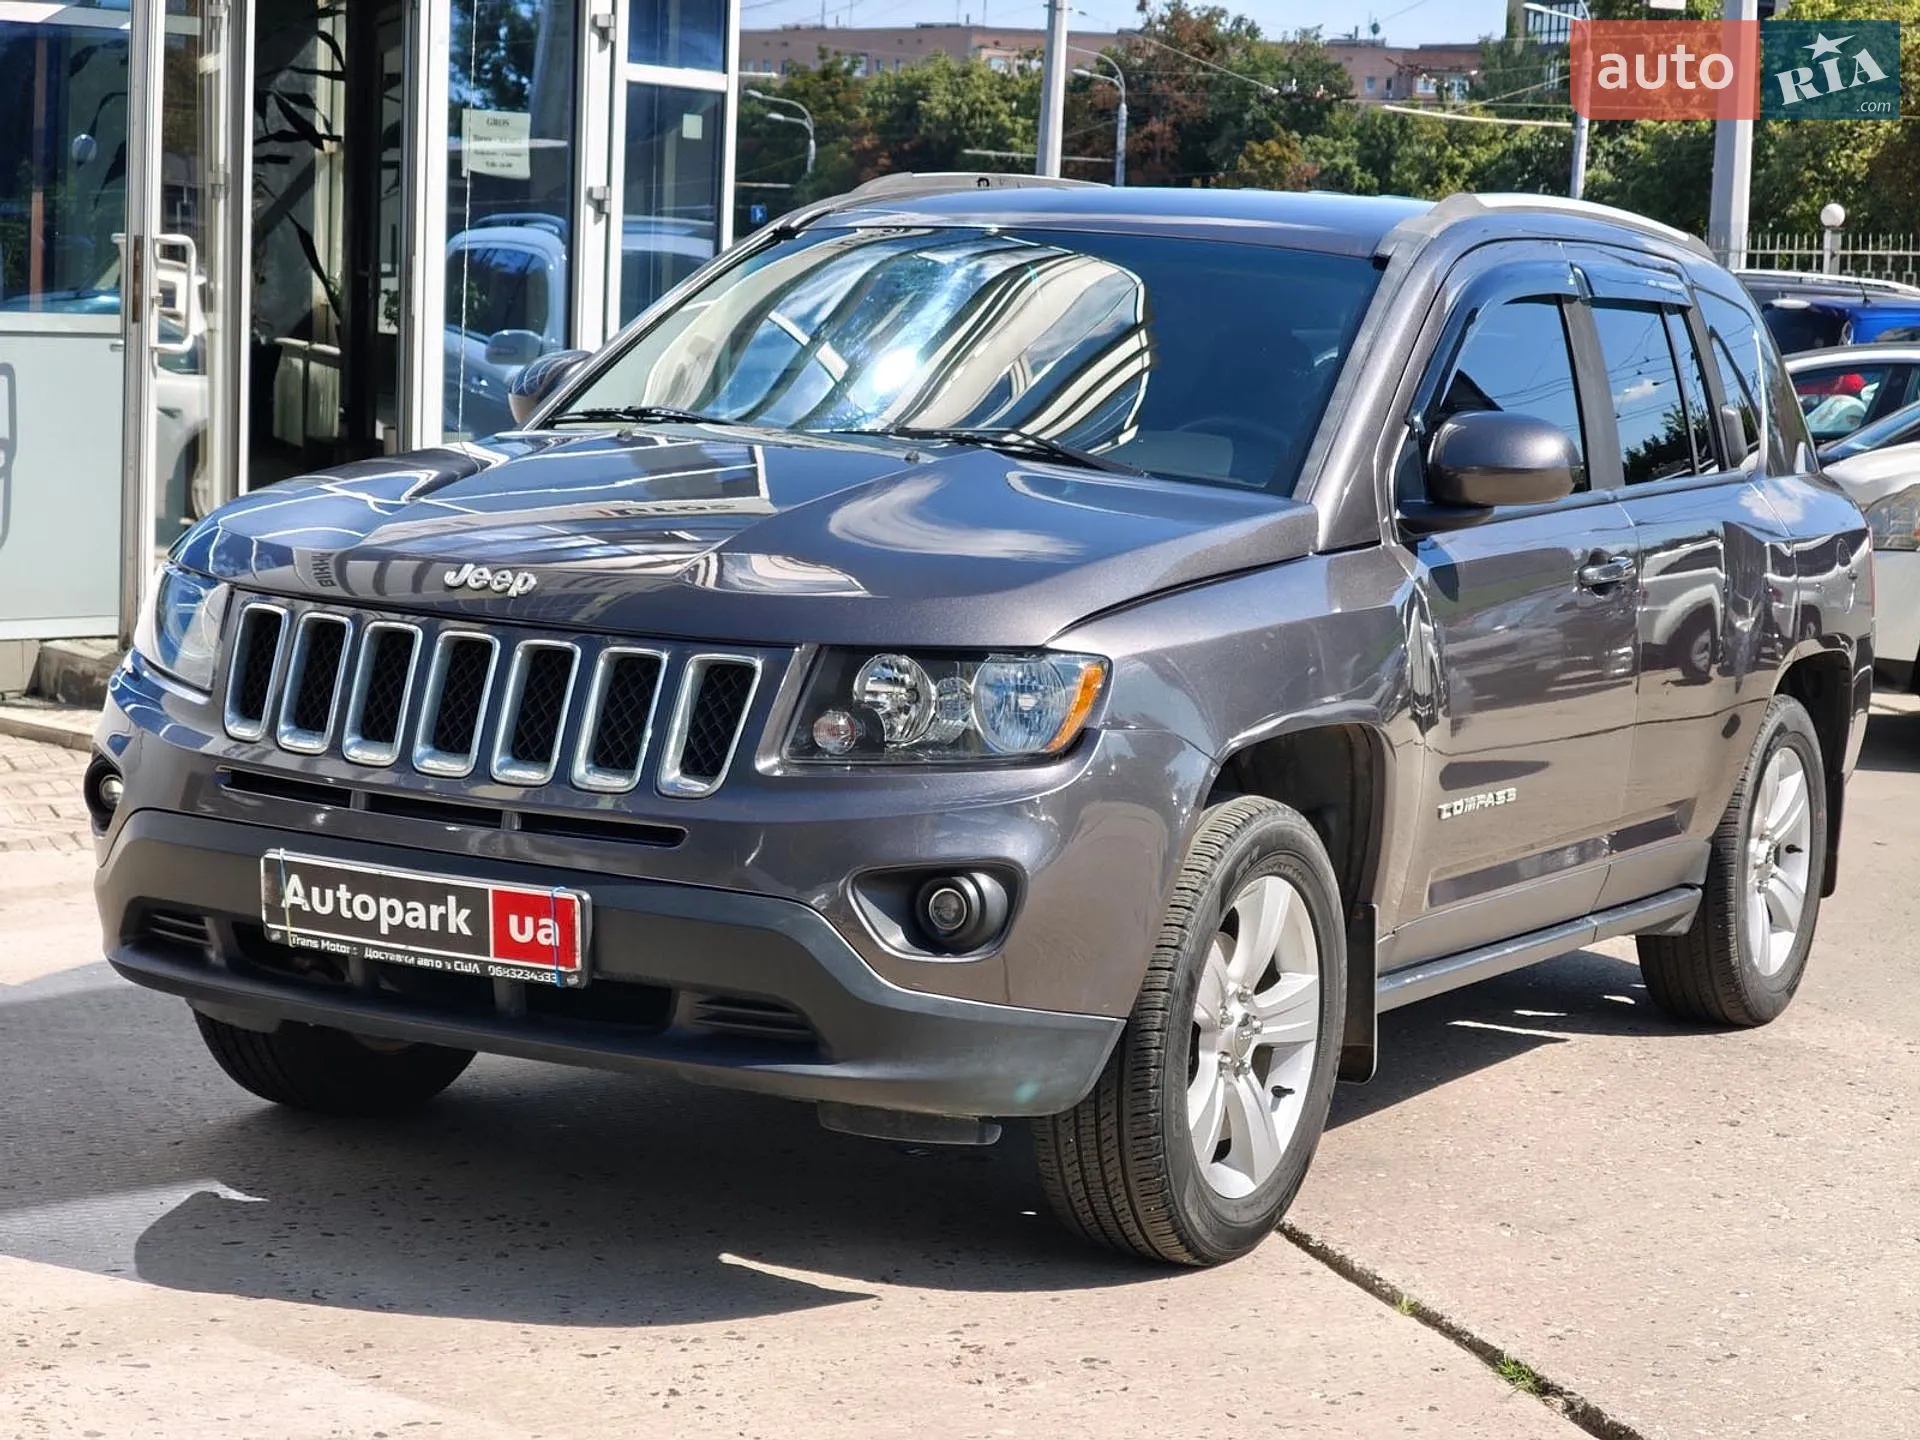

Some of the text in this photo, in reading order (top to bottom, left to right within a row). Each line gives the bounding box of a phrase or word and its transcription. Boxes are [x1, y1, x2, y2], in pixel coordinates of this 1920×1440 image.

[443, 562, 538, 598] Jeep
[1437, 787, 1517, 820] COMPASS
[281, 873, 561, 948] Autopark ua
